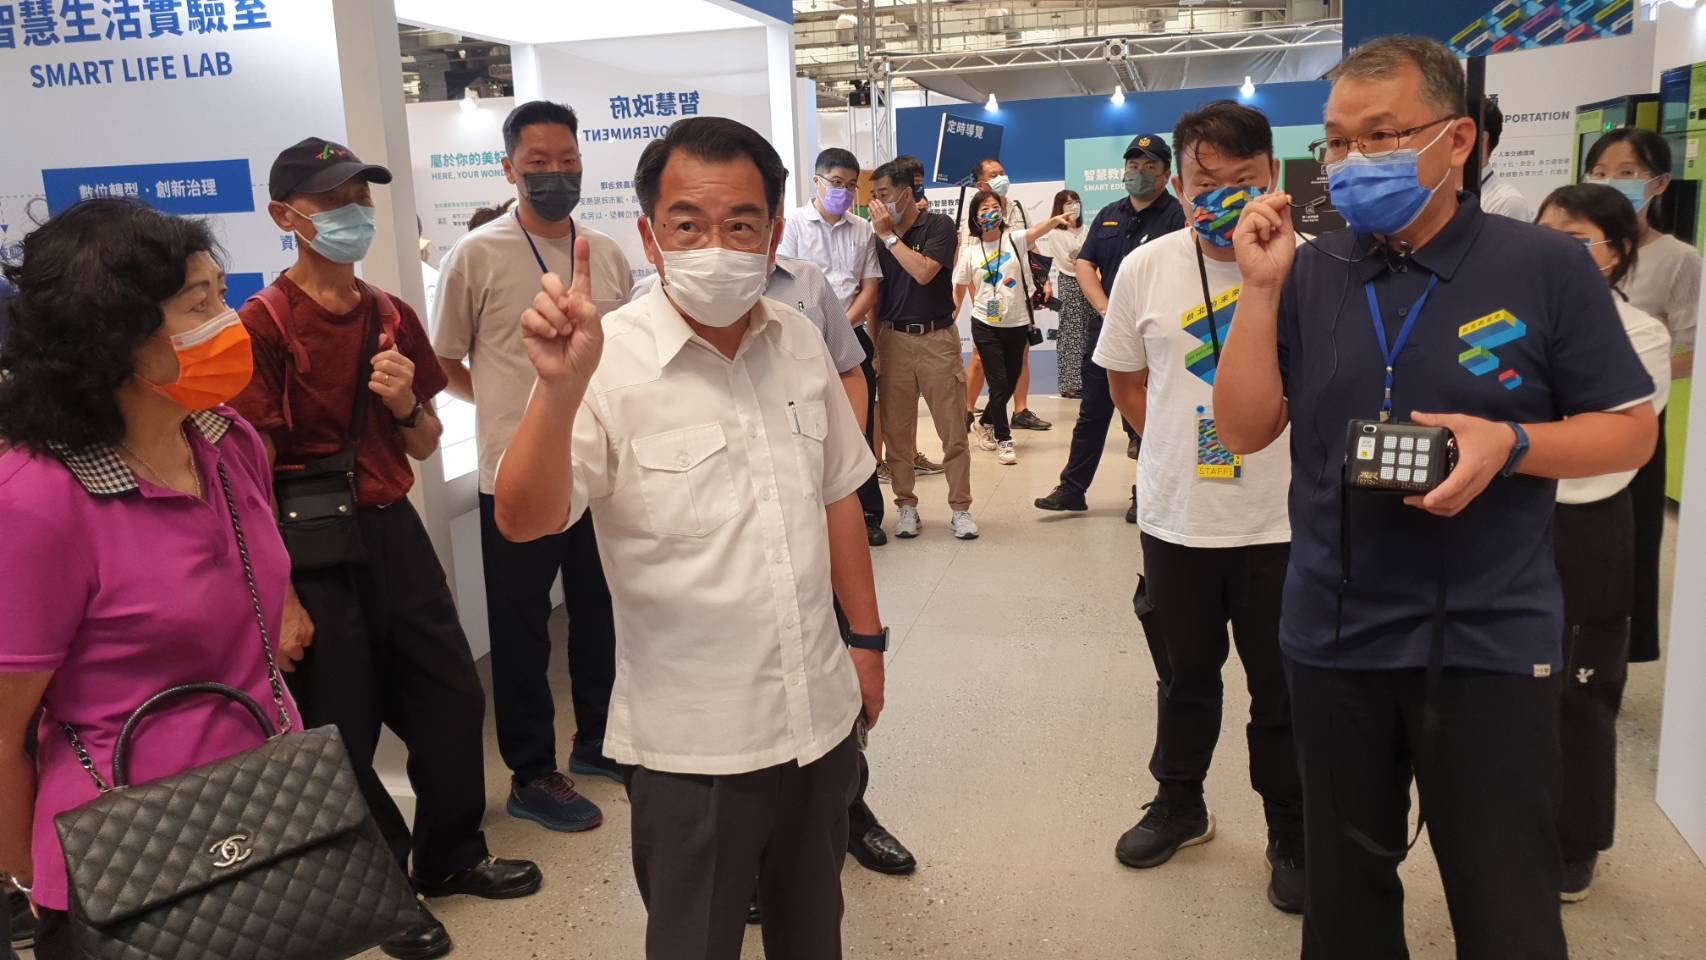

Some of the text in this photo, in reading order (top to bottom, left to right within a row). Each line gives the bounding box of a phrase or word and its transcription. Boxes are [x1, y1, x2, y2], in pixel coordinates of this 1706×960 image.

[30, 52, 233, 88] SMART LIFE LAB
[947, 120, 985, 139] 定時導覽
[432, 172, 455, 180] HERE,
[457, 170, 480, 179] YOUR
[1083, 183, 1108, 192] SMART
